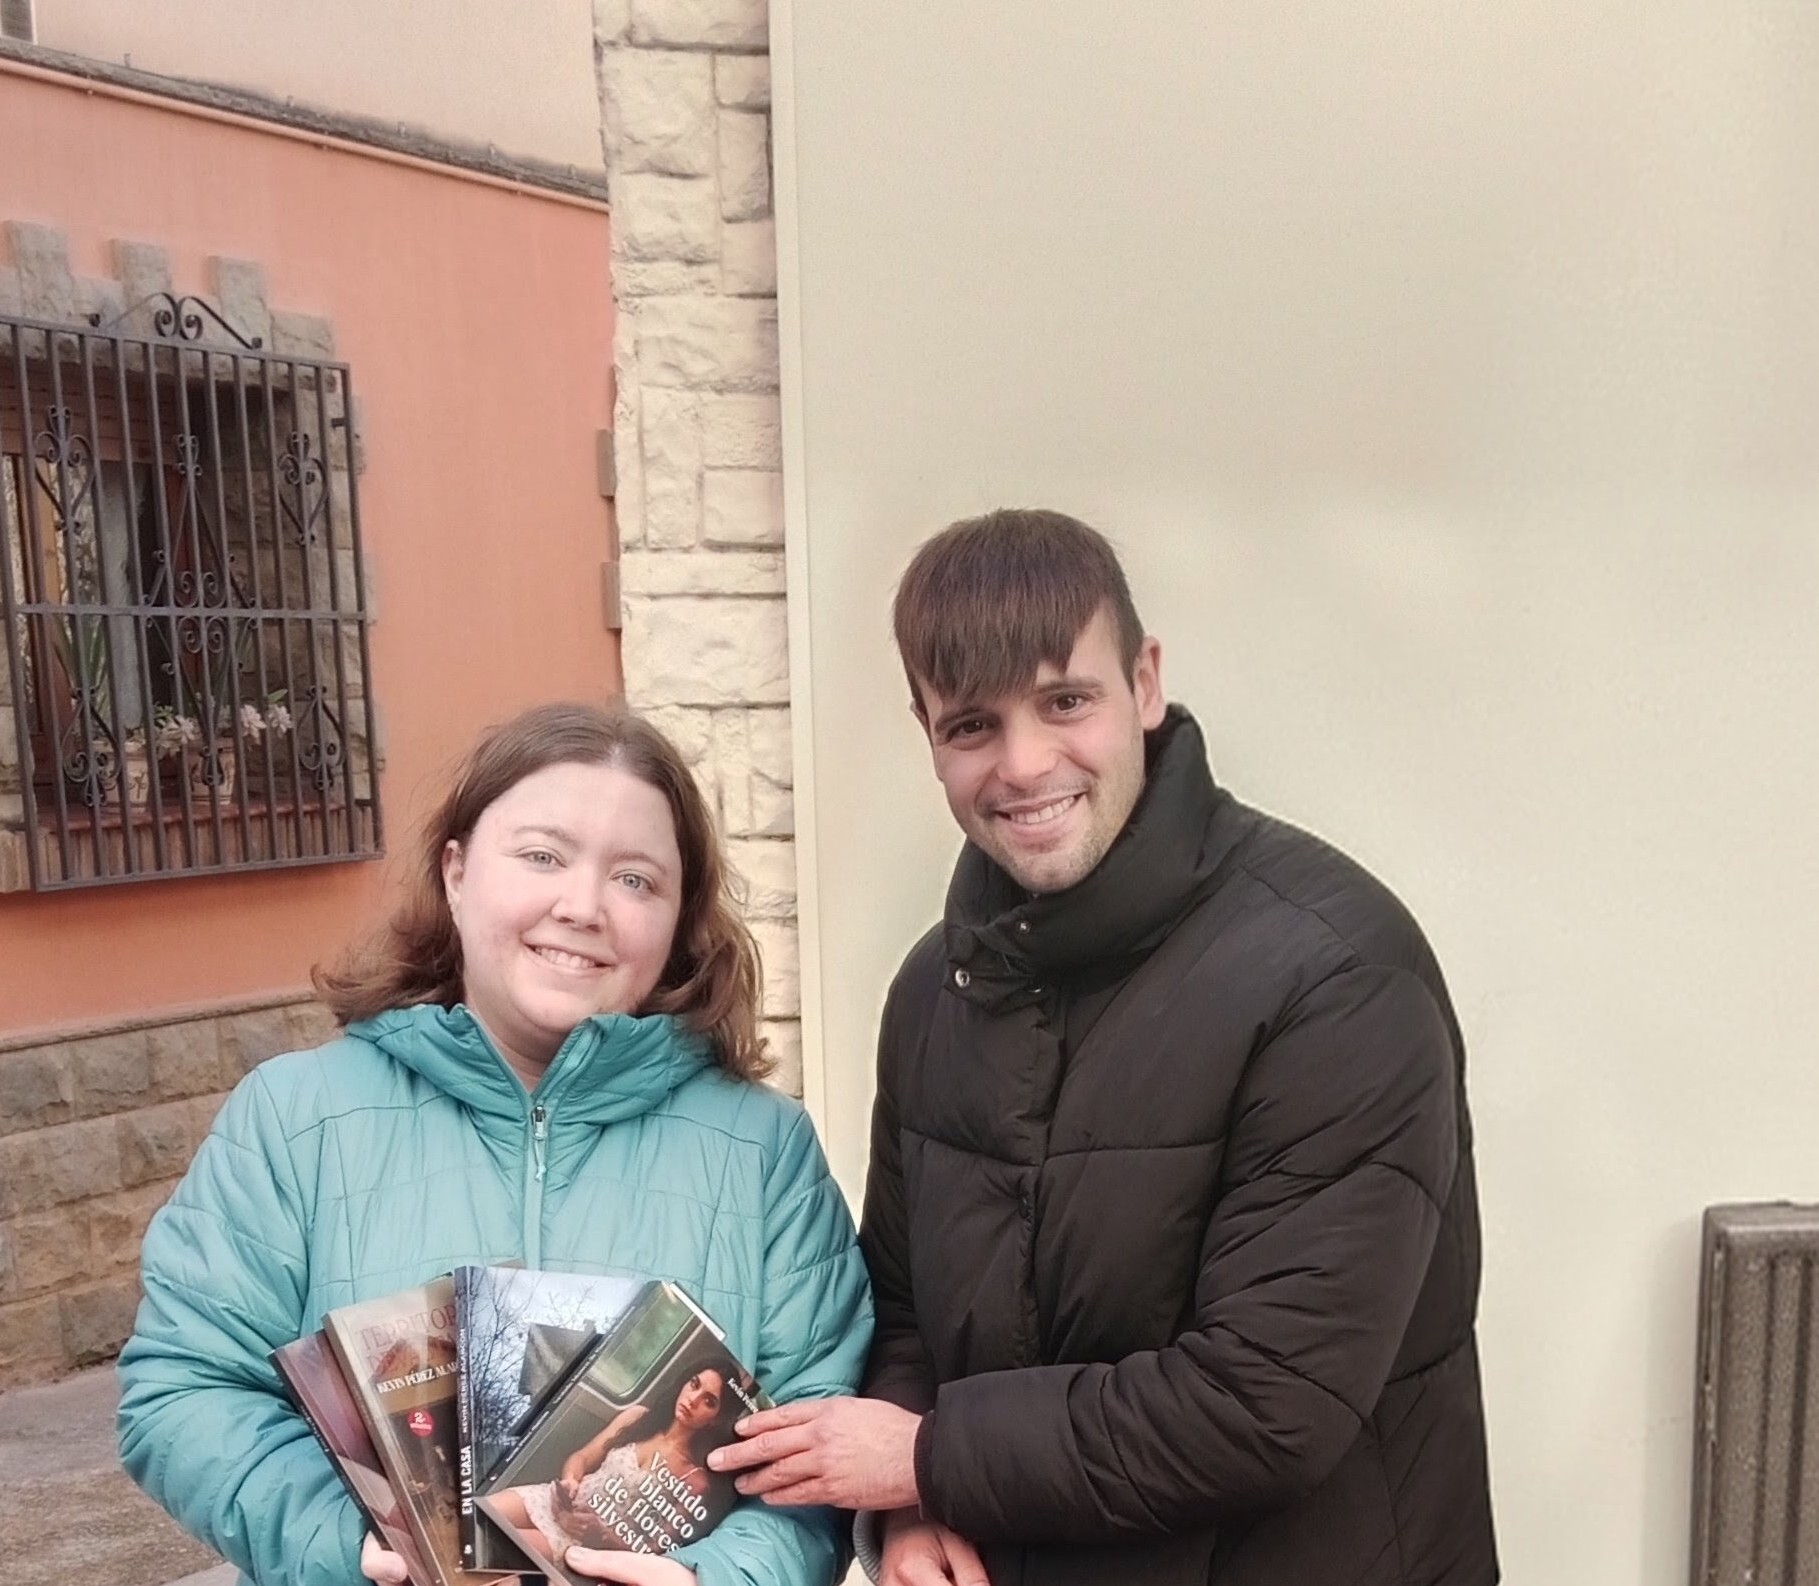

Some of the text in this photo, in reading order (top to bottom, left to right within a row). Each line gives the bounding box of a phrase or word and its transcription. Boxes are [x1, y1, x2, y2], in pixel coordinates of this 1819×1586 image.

[460, 1445, 473, 1515] EN LA CASA
[604, 1476, 629, 1504] de
[638, 1475, 694, 1539] blanco
[650, 1452, 707, 1521] Vestido
